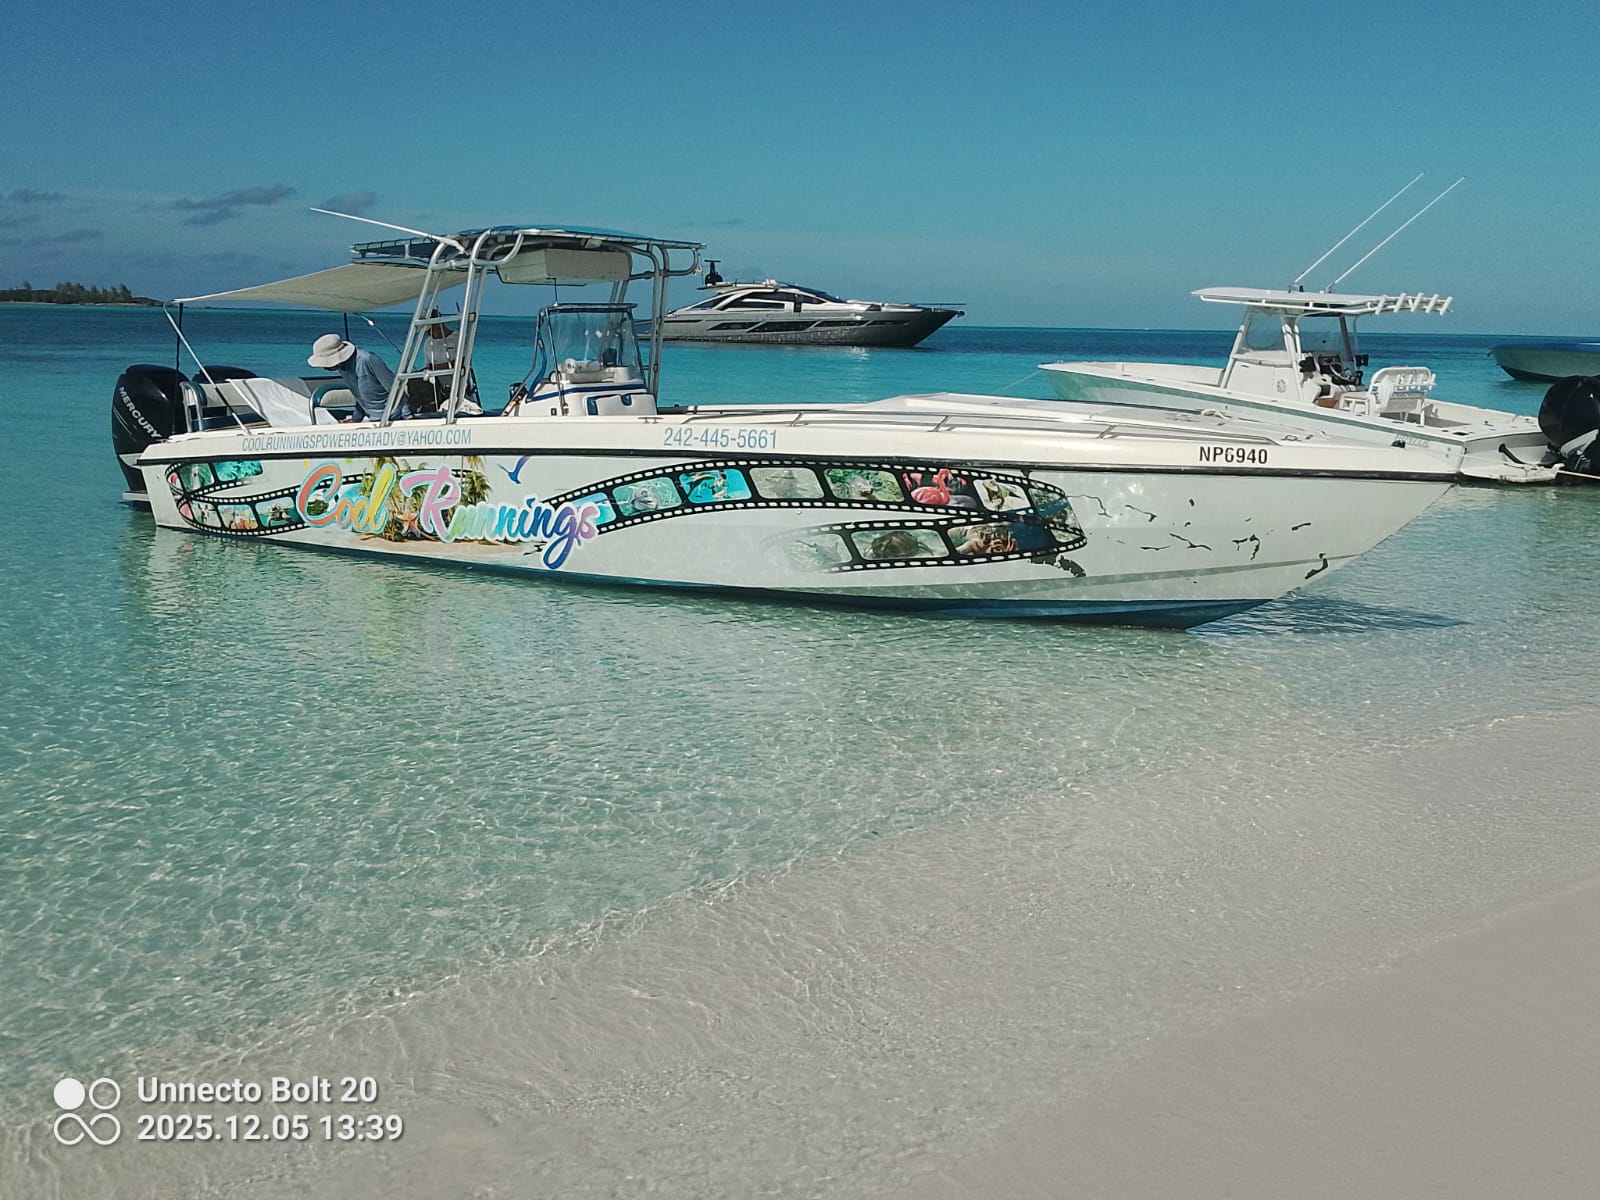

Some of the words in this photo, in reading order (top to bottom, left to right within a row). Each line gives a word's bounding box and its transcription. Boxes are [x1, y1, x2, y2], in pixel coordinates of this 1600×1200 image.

[119, 386, 163, 438] MERCURY
[242, 429, 473, 452] COOLRUNNINGSPOWERBOATADV@YAHOO.COM
[663, 426, 778, 449] 242-445-5661
[1199, 445, 1269, 465] NP6940
[298, 463, 395, 533] Cool
[401, 466, 599, 570] Runnings
